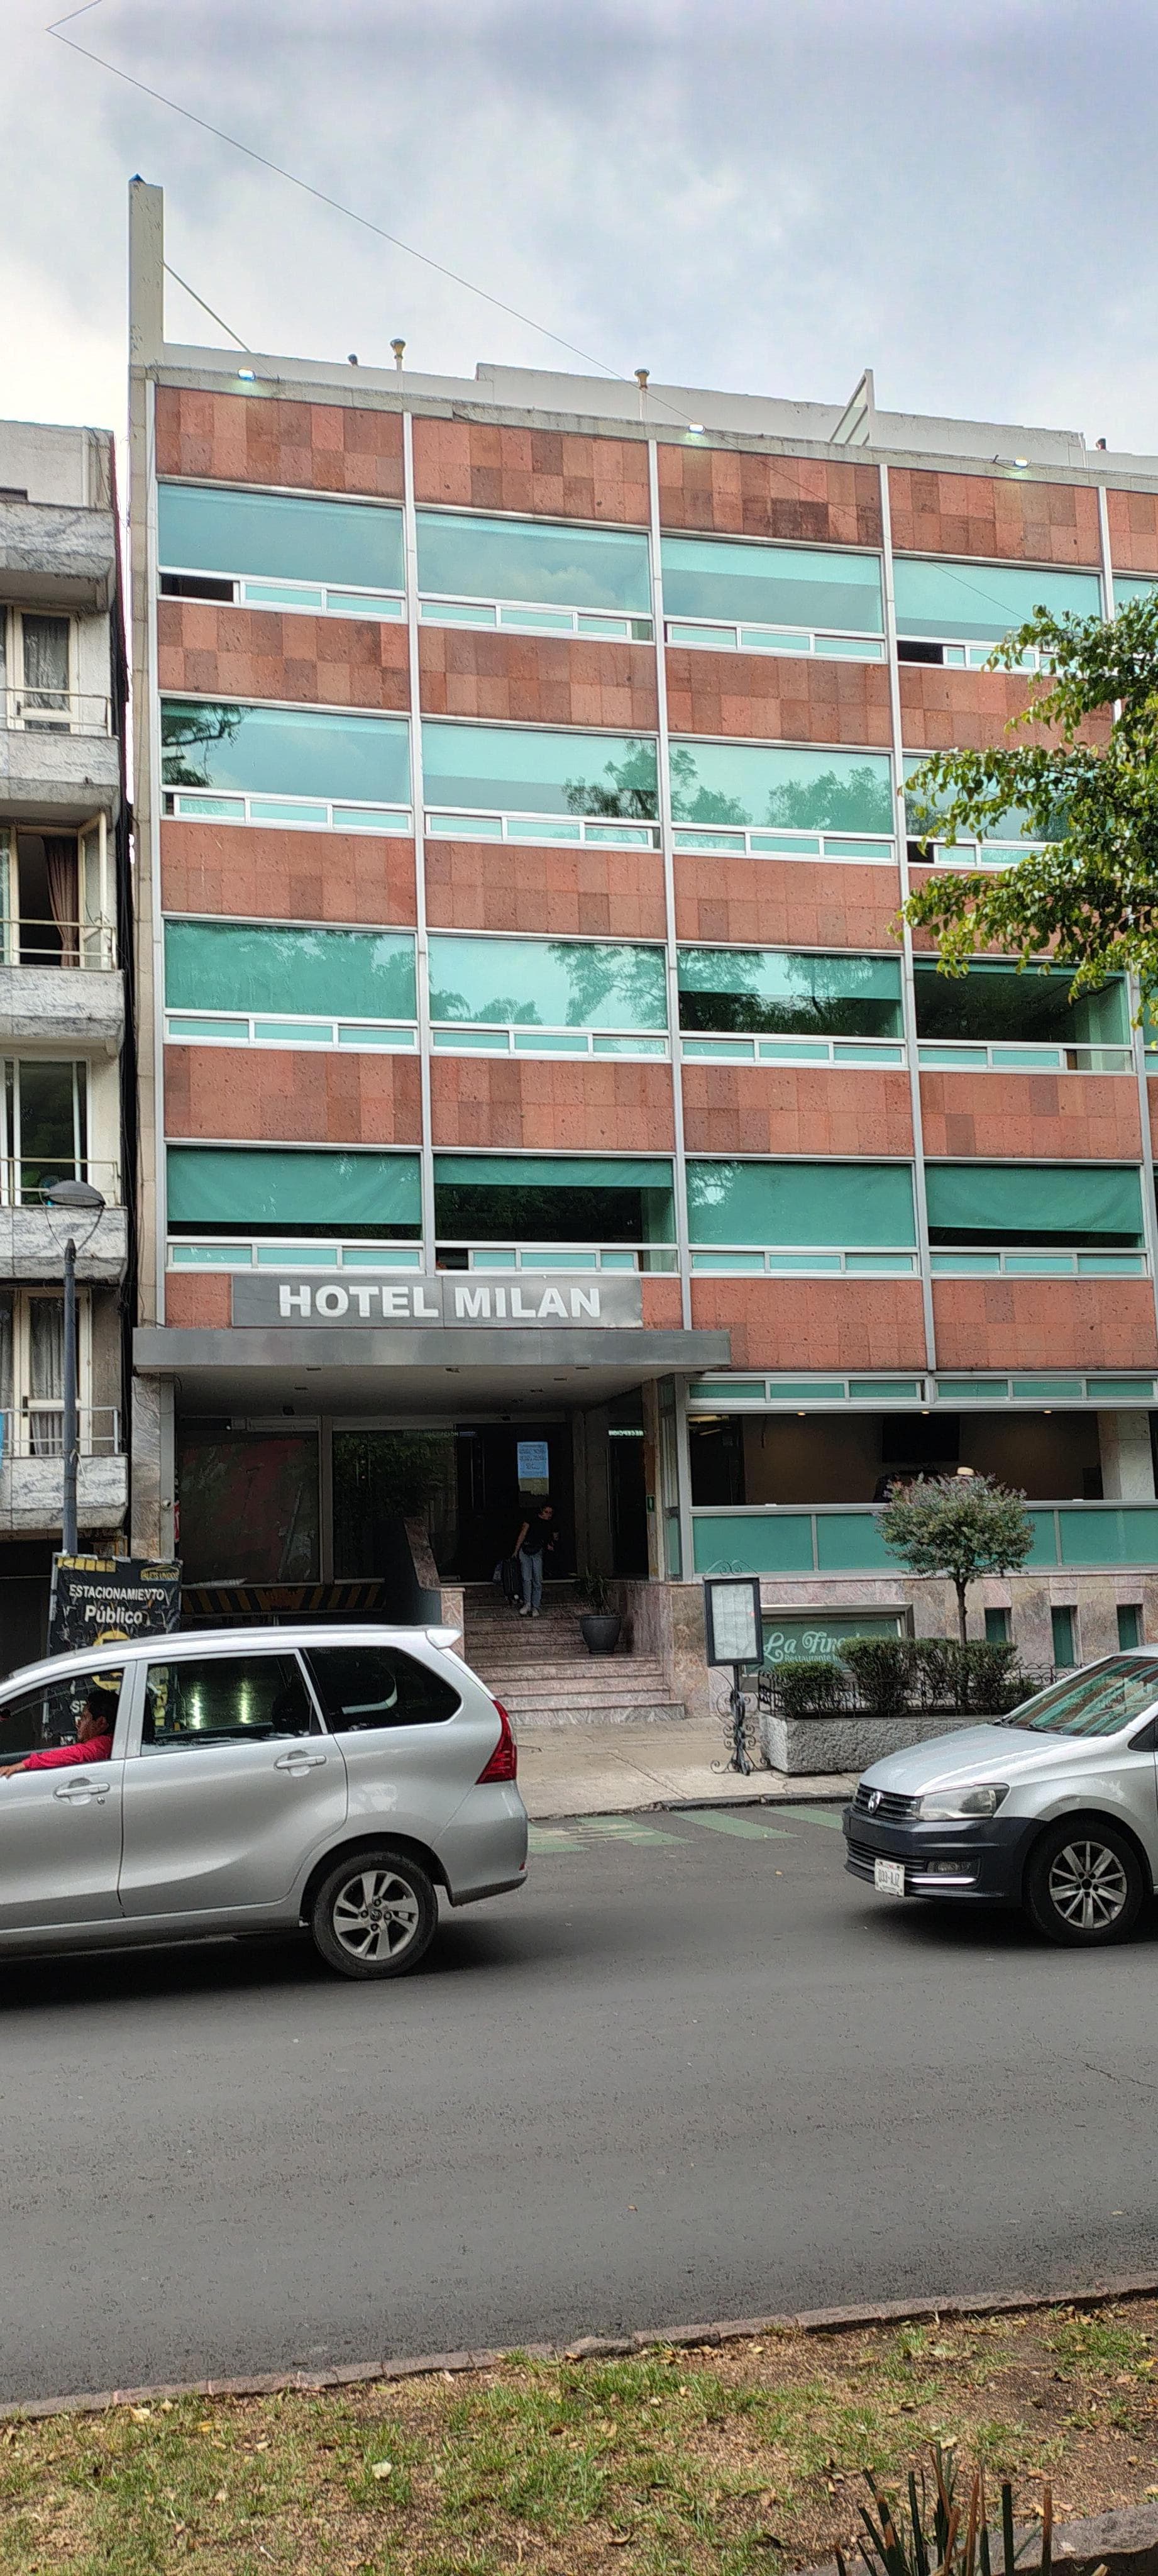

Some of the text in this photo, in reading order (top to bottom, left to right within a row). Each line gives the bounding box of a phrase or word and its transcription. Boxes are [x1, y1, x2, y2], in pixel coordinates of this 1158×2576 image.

[279, 1284, 601, 1319] HOTEL MILAN
[84, 1604, 143, 1624] Público
